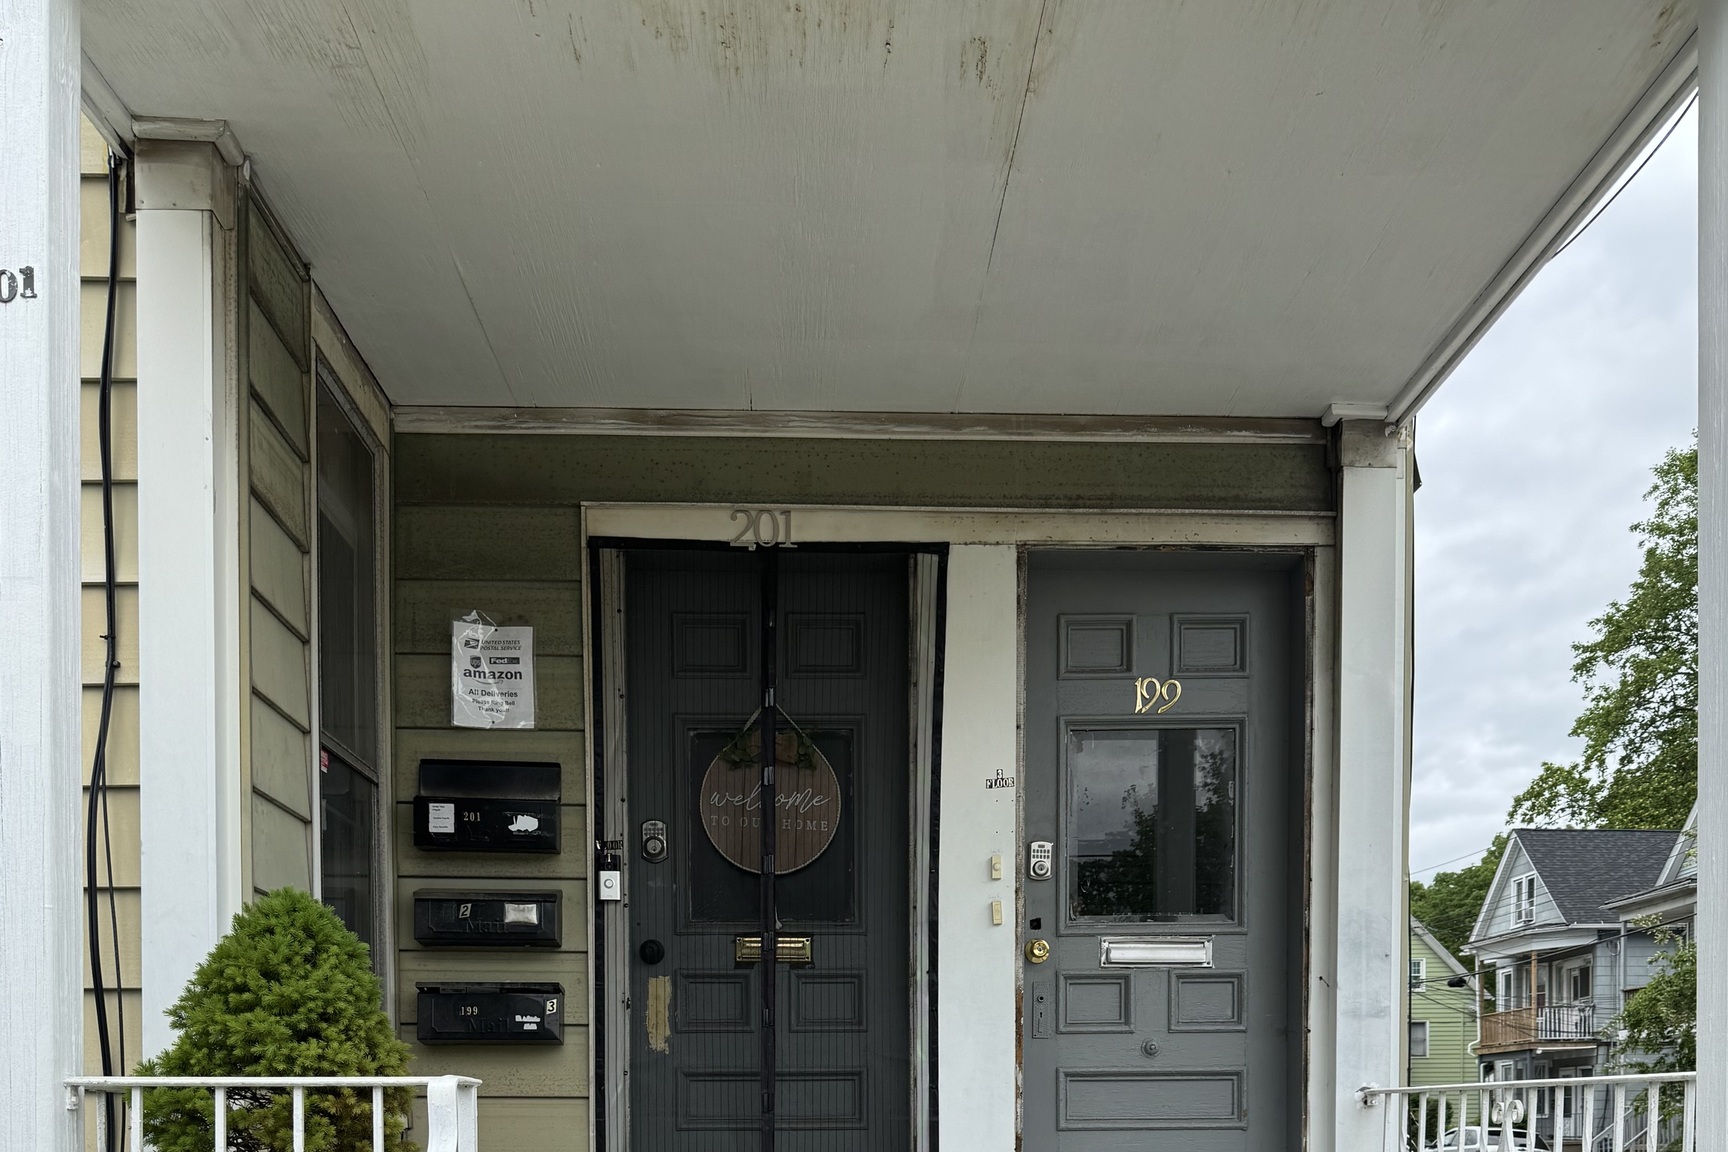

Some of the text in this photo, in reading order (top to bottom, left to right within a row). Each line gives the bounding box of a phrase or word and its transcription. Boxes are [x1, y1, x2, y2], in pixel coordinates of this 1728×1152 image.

[730, 509, 798, 550] 201
[463, 669, 522, 680] amazon
[481, 690, 518, 698] Deliveries
[1134, 676, 1182, 714] 199
[986, 777, 1015, 789] FLOOR
[710, 780, 831, 813] welome
[463, 811, 481, 822] 201
[710, 815, 828, 831] TO OU HOME
[460, 905, 469, 917] 2
[461, 1006, 478, 1016] 199
[547, 1000, 555, 1013] 3
